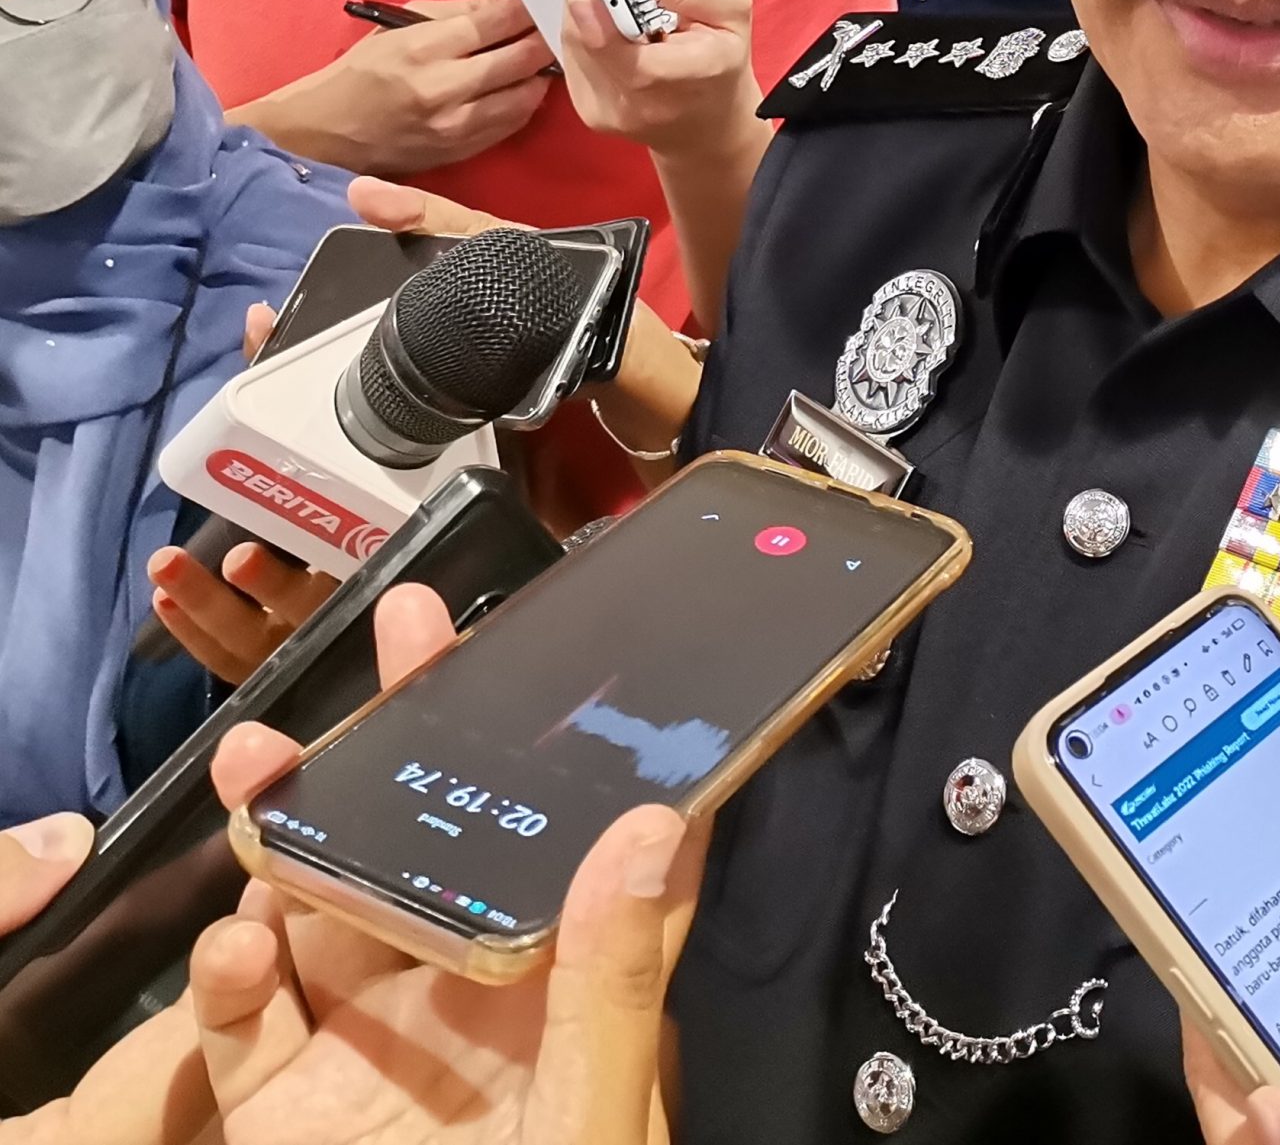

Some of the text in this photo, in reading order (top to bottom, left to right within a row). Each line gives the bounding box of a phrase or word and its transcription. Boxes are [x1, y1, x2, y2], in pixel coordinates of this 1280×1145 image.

[787, 425, 877, 491] MIOR FARID
[221, 459, 342, 534] BERITA
[1232, 935, 1273, 977] anggota
